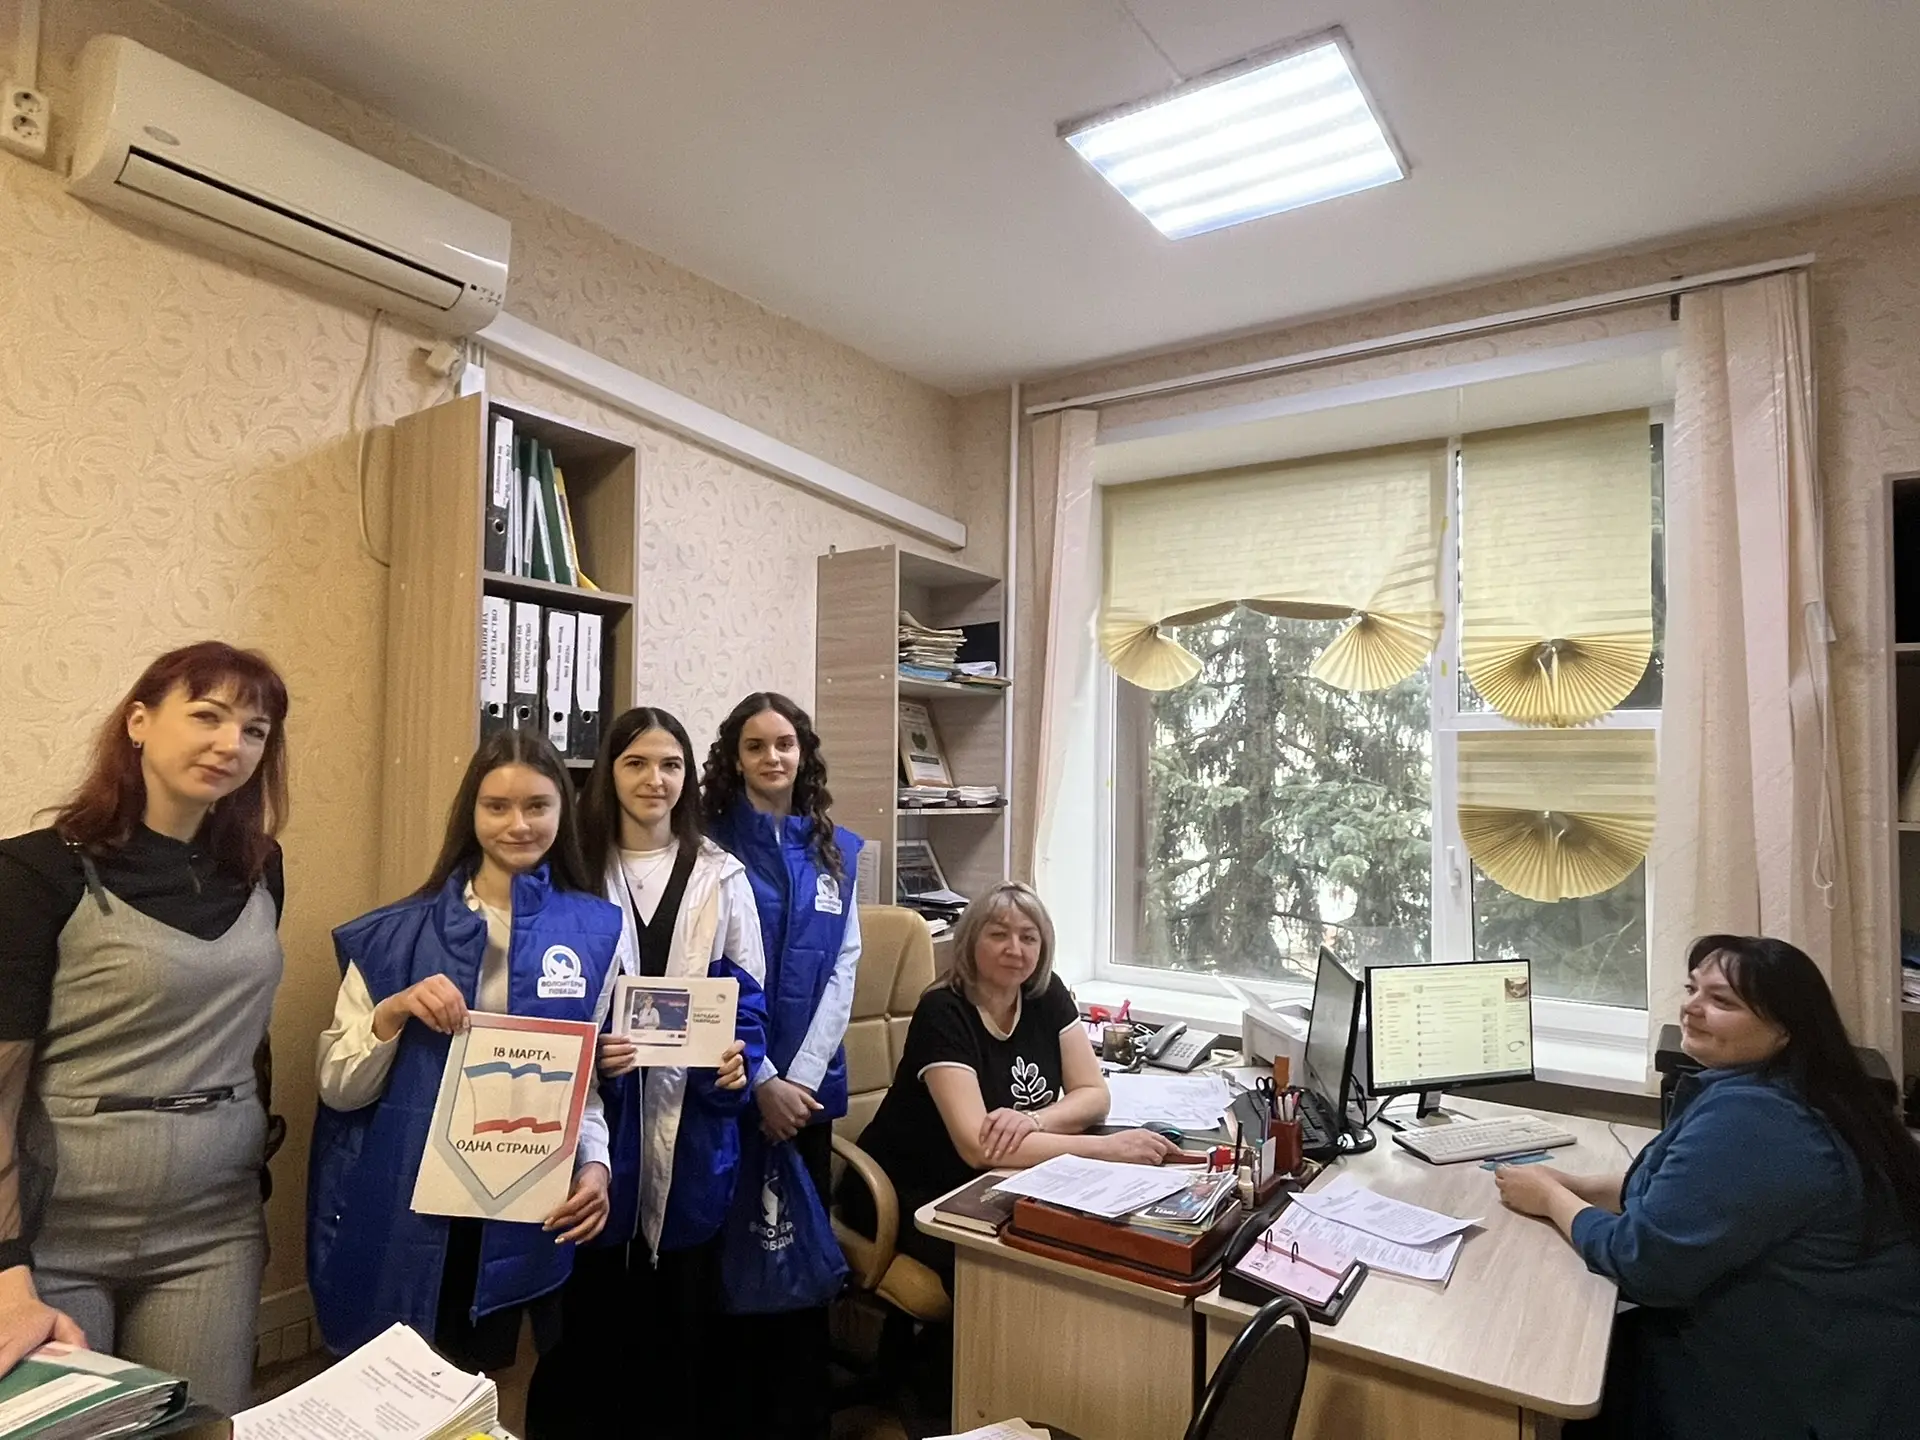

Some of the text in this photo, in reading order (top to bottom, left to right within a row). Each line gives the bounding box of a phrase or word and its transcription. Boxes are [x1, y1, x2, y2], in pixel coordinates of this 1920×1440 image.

[489, 609, 498, 687] СТРОИТЕЛЬСТВО
[523, 622, 532, 684] СТРОИТЕЛЬСТВО
[493, 1046, 505, 1058] 18
[456, 1139, 550, 1156] ОДНА СТРАНА!
